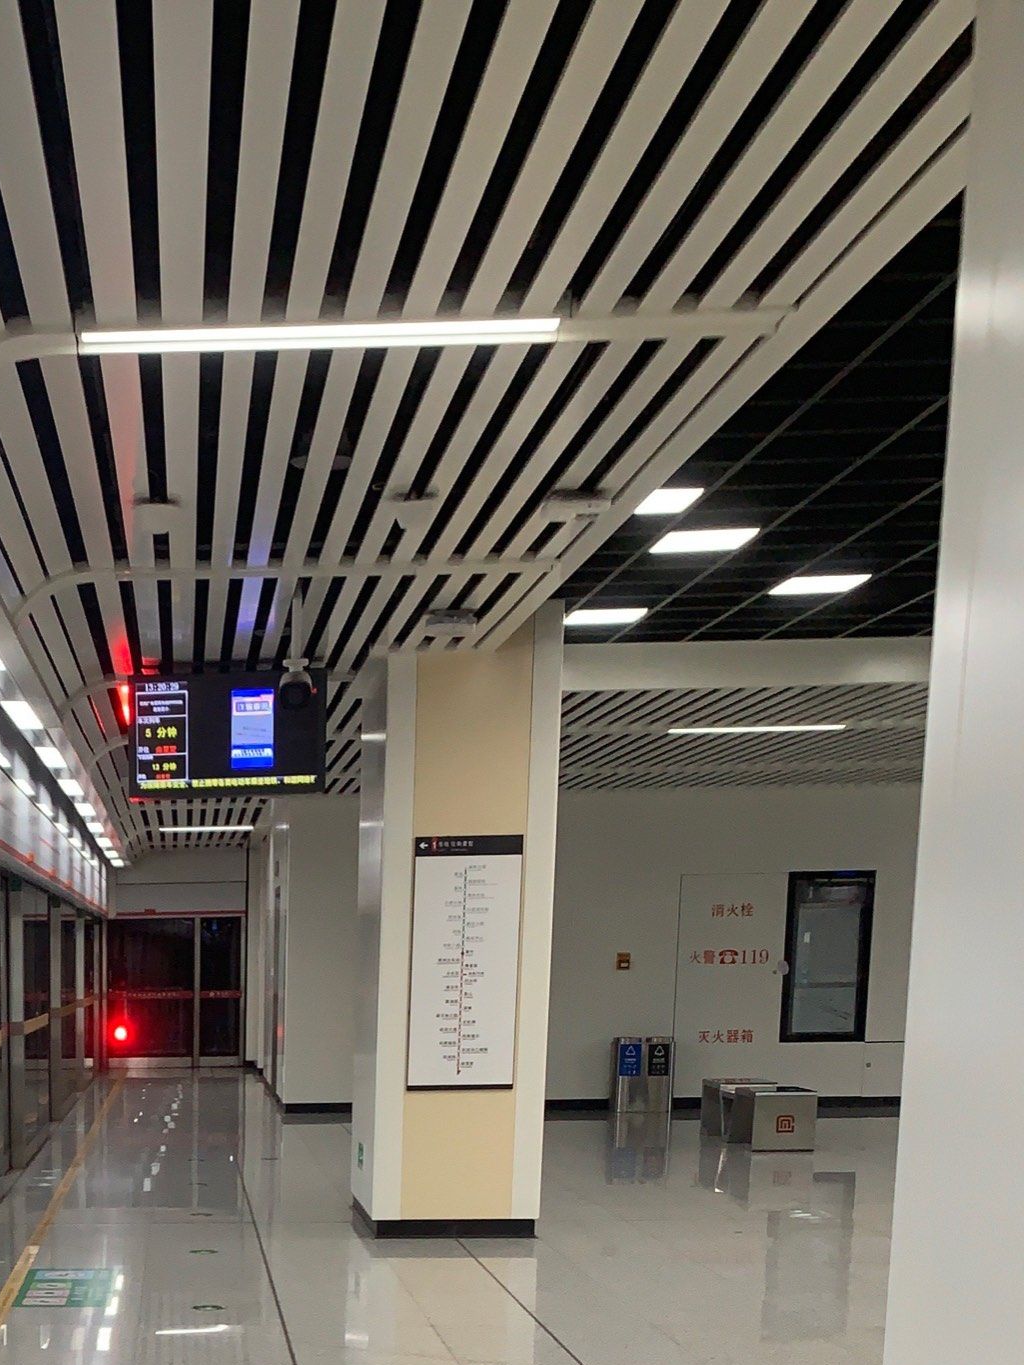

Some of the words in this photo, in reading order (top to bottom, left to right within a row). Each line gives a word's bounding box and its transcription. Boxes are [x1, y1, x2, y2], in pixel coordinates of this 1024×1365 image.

[157, 726, 178, 738] 分钟
[711, 903, 754, 918] 消火栓
[690, 951, 715, 965] 火警
[741, 950, 770, 965] 119
[699, 1029, 754, 1044] 灭火器箱
